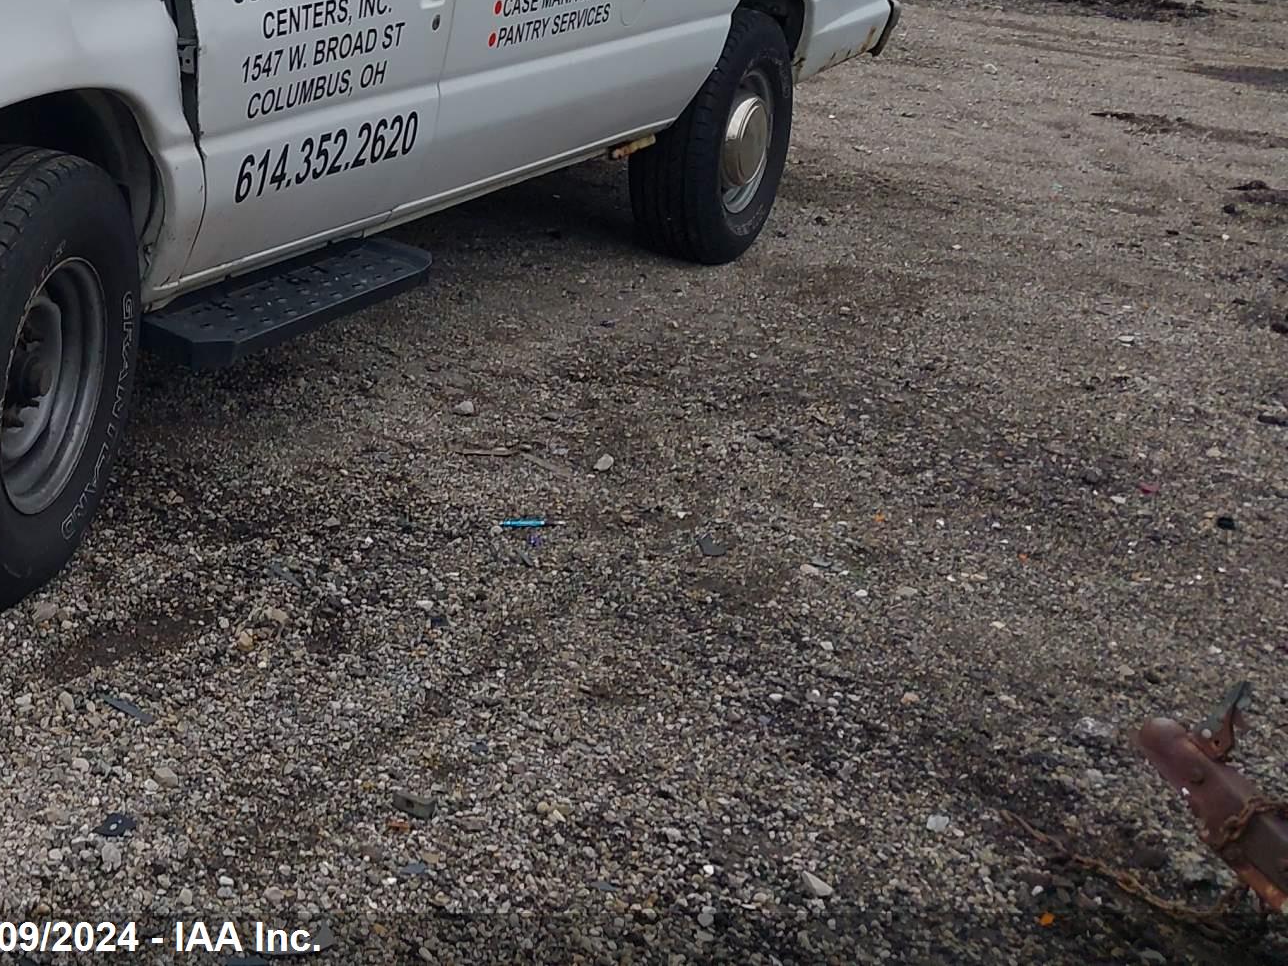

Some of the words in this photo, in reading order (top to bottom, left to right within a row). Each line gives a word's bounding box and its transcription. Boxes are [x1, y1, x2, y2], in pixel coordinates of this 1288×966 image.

[242, 50, 283, 83] 1547
[289, 43, 307, 71] W.
[313, 28, 377, 65] BROAD
[382, 22, 405, 49] ST
[496, 17, 551, 49] PANTRY
[551, 3, 611, 35] SERVICES
[247, 69, 353, 119] COLUMBUS,
[361, 60, 387, 88] OH
[234, 110, 418, 204] 614.352.2620
